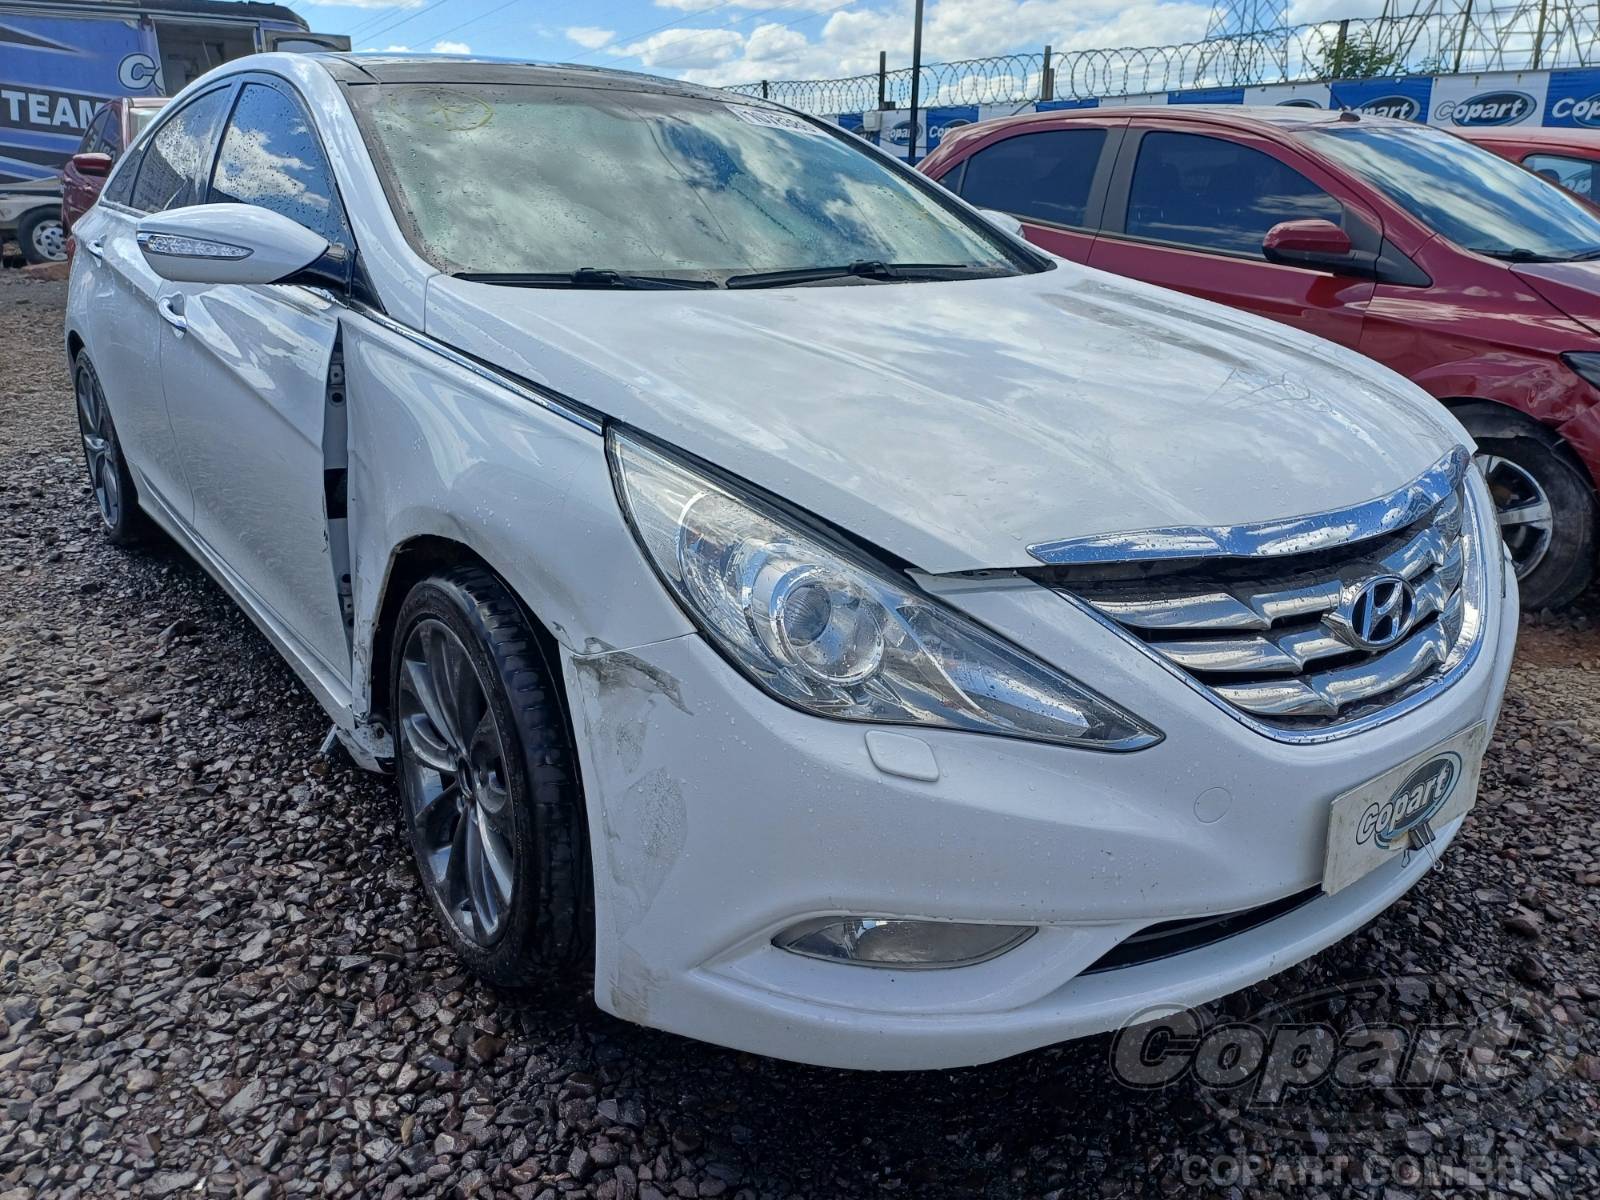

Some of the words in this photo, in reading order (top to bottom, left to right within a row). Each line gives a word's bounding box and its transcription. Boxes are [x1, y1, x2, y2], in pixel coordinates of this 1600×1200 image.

[1, 89, 105, 129] TEAM
[1434, 98, 1522, 122] Copart
[1356, 760, 1451, 845] Copart
